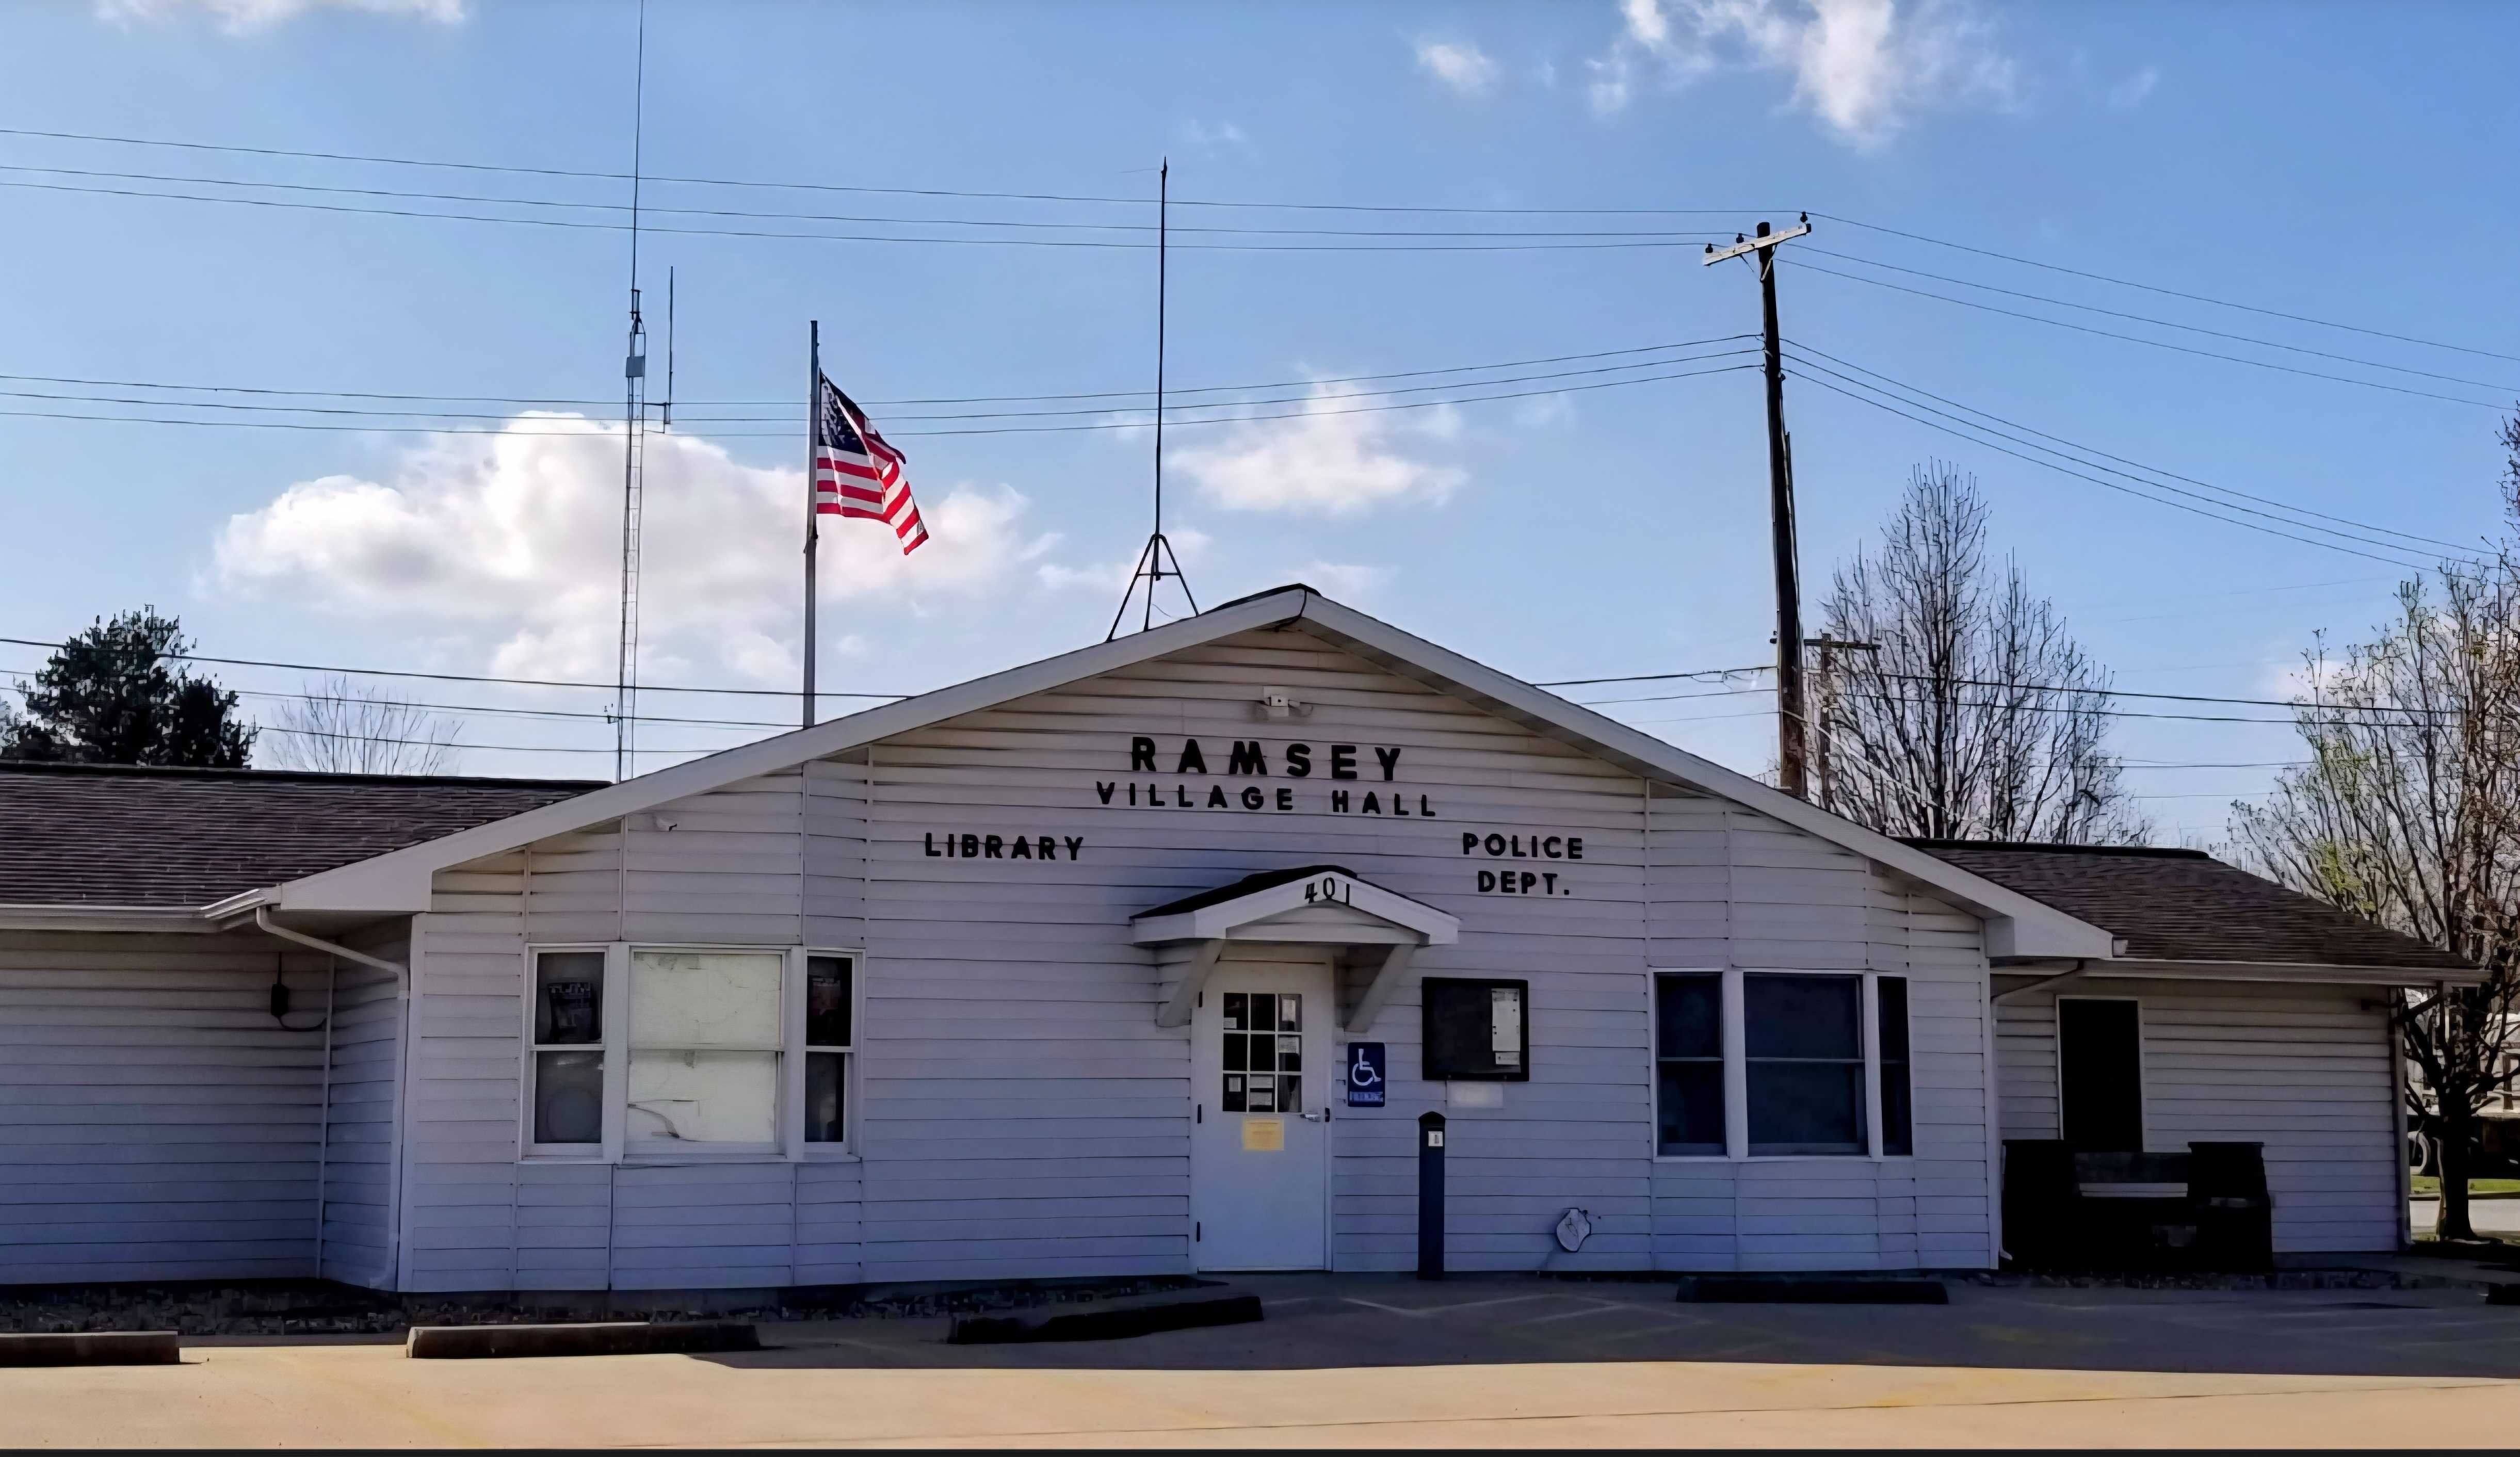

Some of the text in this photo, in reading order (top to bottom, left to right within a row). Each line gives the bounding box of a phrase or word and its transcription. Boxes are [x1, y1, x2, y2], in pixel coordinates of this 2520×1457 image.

[1130, 735, 1401, 782] RAMSEY
[1095, 781, 1436, 818] VILLAGE HALL
[924, 832, 1084, 862] LIBRARY
[1462, 832, 1584, 861] POLICE
[1304, 877, 1350, 905] 401
[1477, 869, 1570, 896] DEPT.
